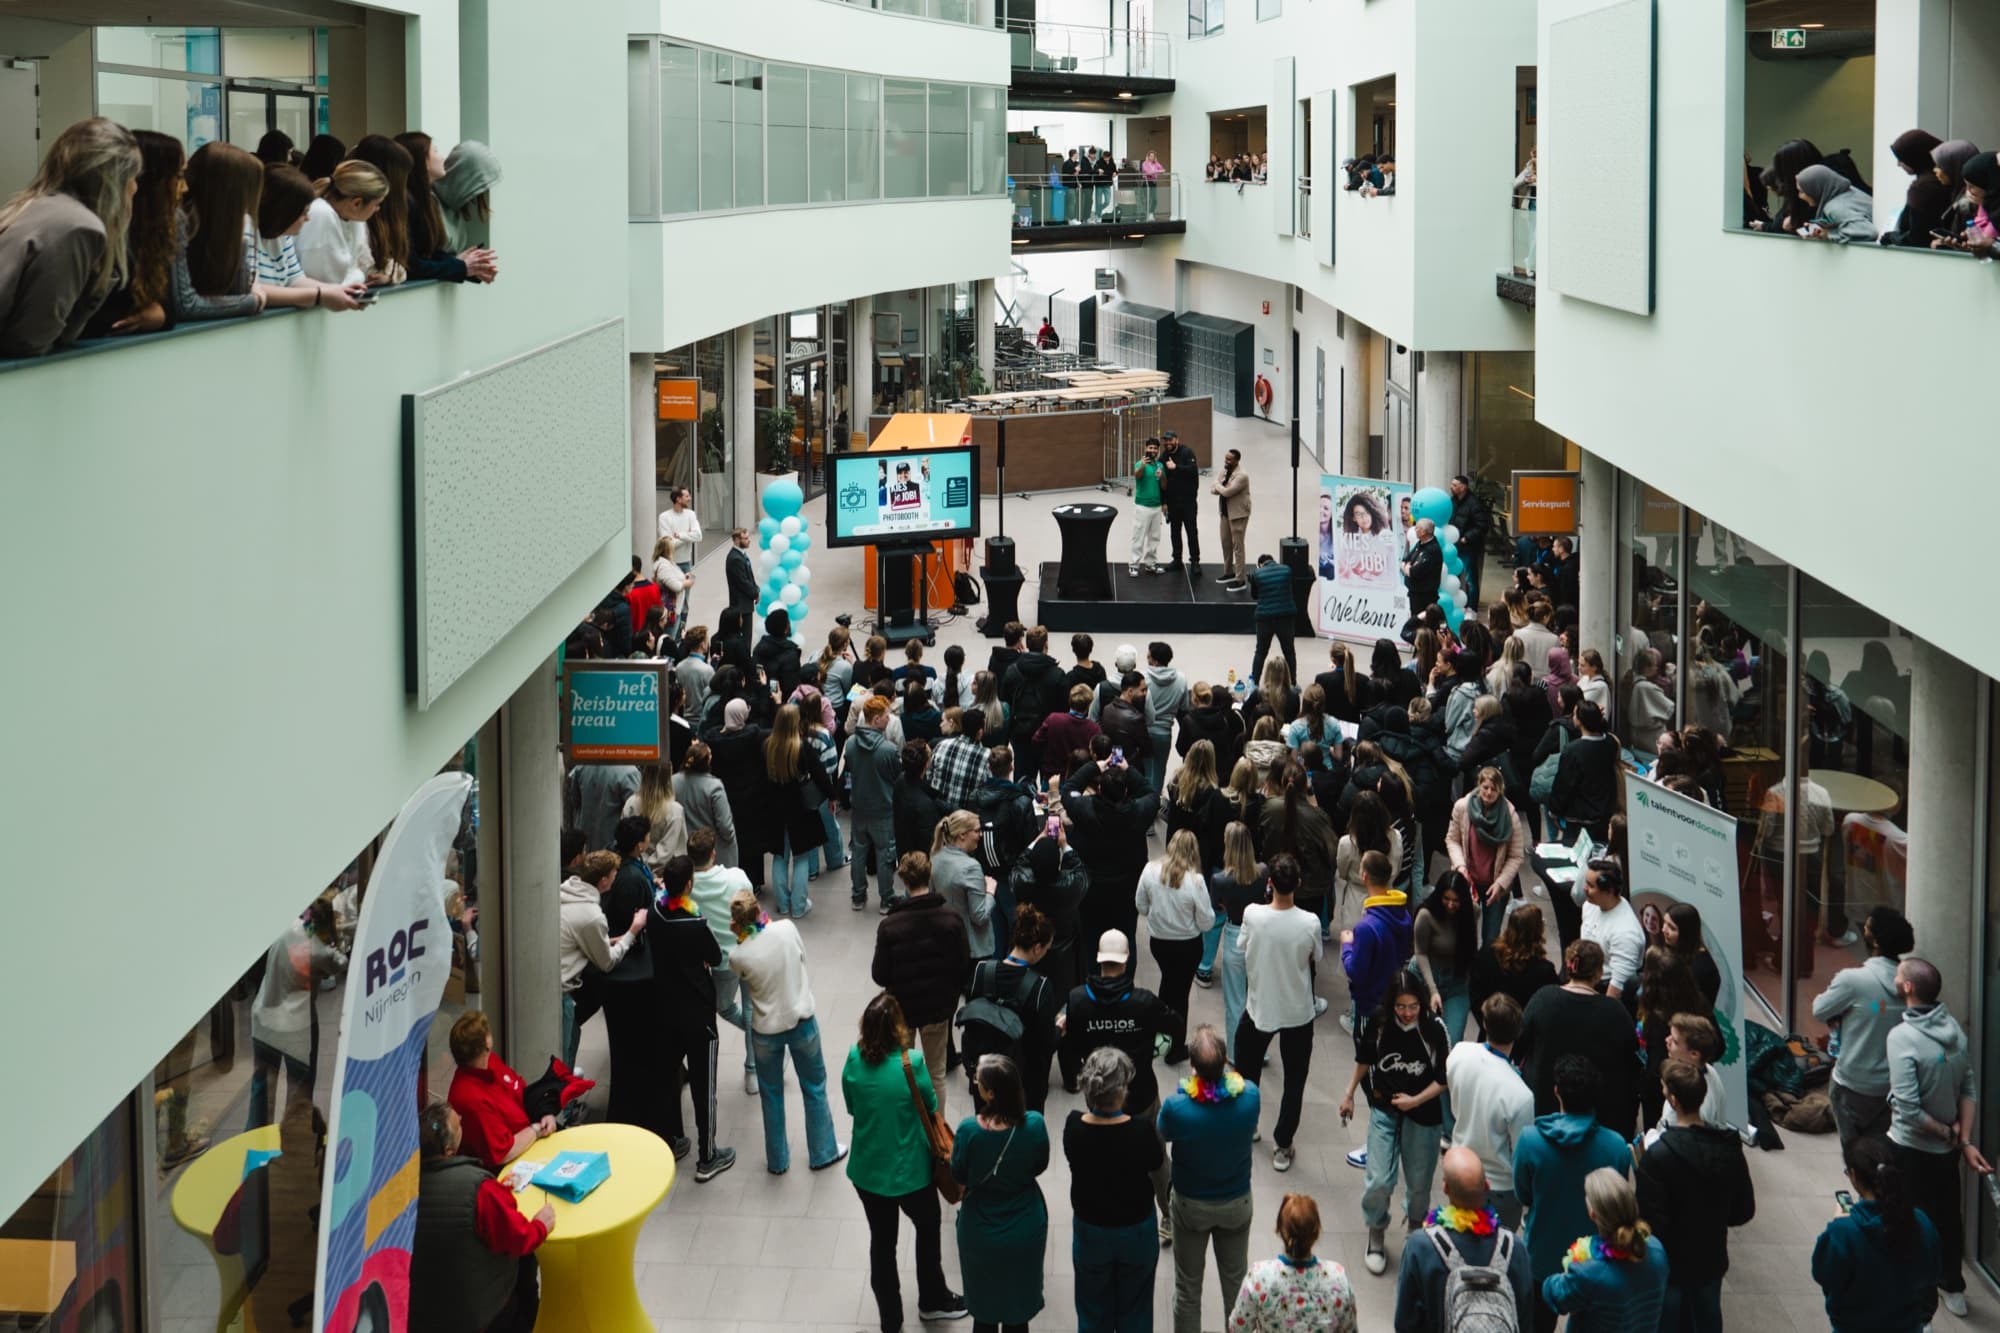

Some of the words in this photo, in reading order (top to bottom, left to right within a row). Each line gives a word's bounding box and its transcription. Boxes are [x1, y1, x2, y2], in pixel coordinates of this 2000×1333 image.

[1522, 500, 1570, 510] Servicepunt
[883, 512, 919, 521] PHOTOBOOTH
[1343, 532, 1370, 551] KIES
[618, 679, 647, 695] het
[570, 689, 657, 711] Reisburea
[1651, 800, 1727, 841] talentvoordocent
[366, 919, 429, 998] ROC
[365, 970, 421, 1028] Nijmegn
